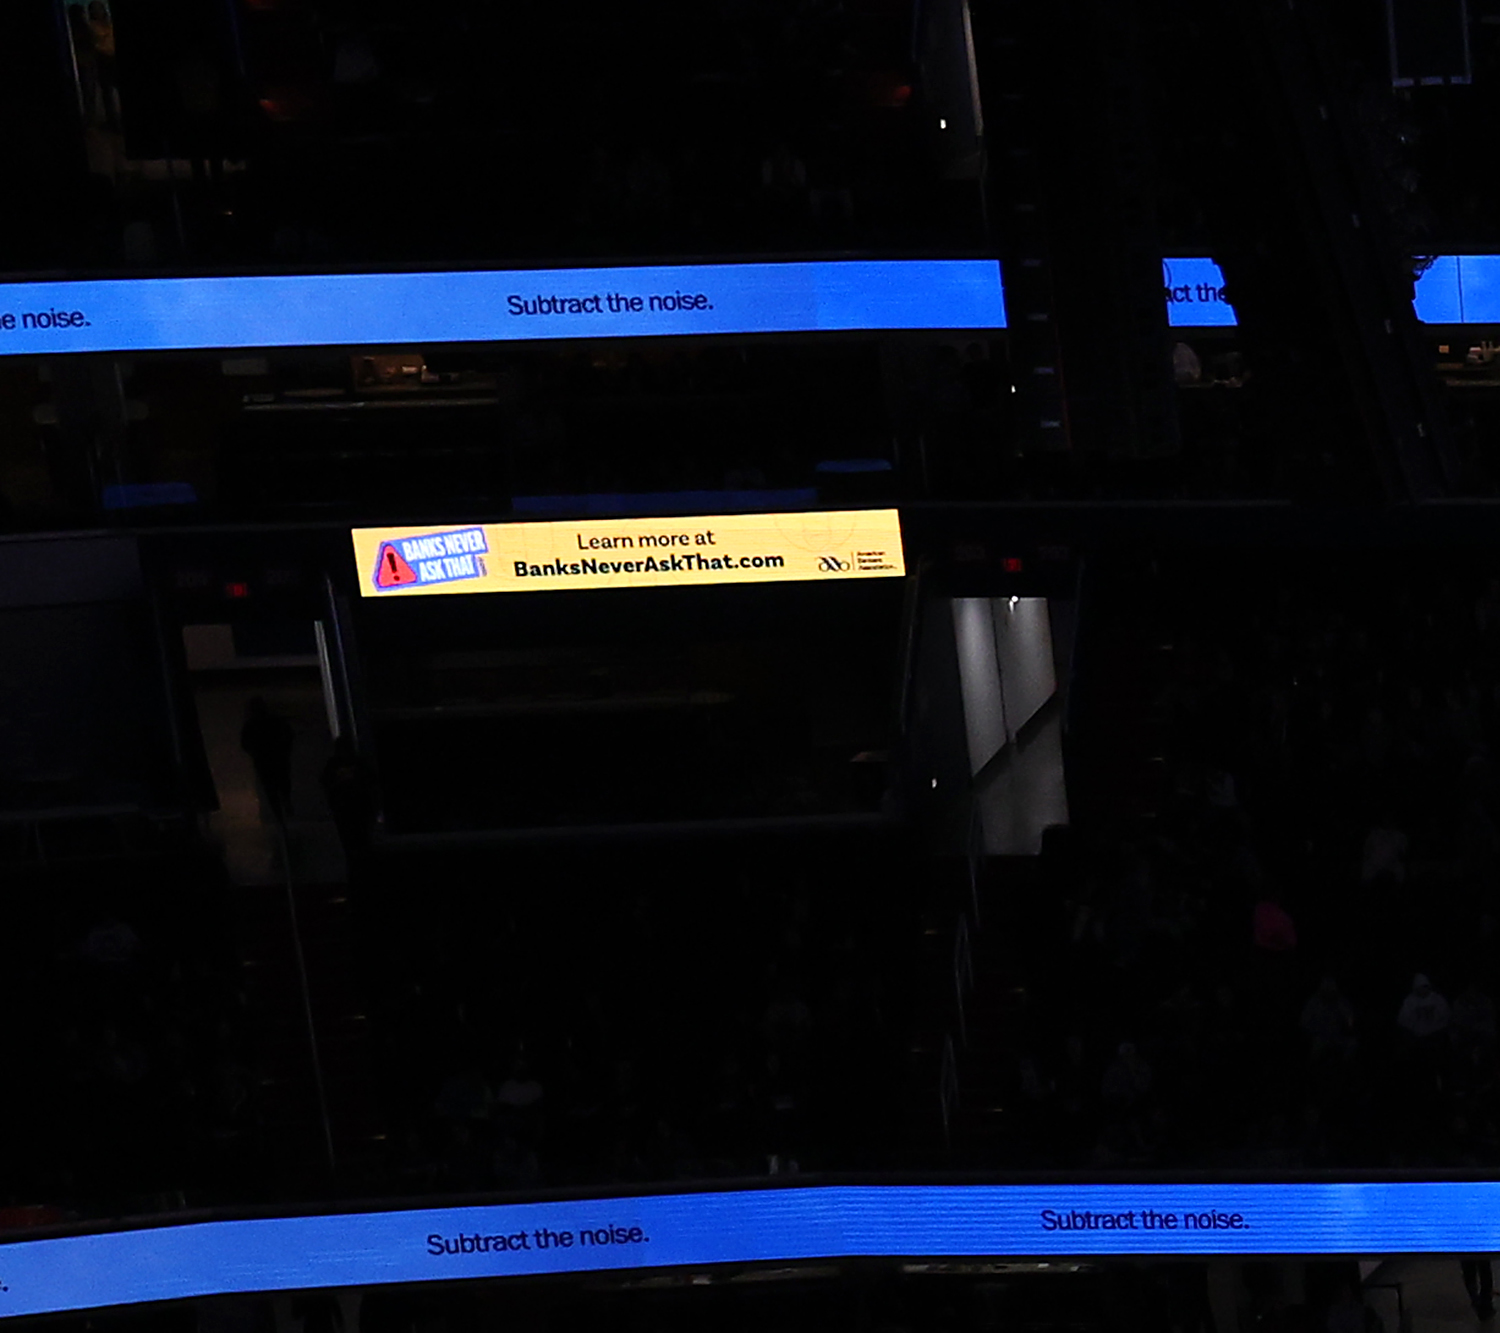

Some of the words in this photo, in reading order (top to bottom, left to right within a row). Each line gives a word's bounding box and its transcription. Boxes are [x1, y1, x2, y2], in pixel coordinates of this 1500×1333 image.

[506, 294, 604, 316] Subtract
[605, 292, 644, 313] the
[648, 289, 714, 312] noise.
[576, 533, 634, 551] Learn
[638, 534, 690, 548] more
[694, 530, 716, 546] at
[513, 552, 785, 577] BanksNeverAskThat.com
[426, 1230, 531, 1256] Subtract
[532, 1227, 574, 1250] the
[579, 1223, 650, 1246] noise.
